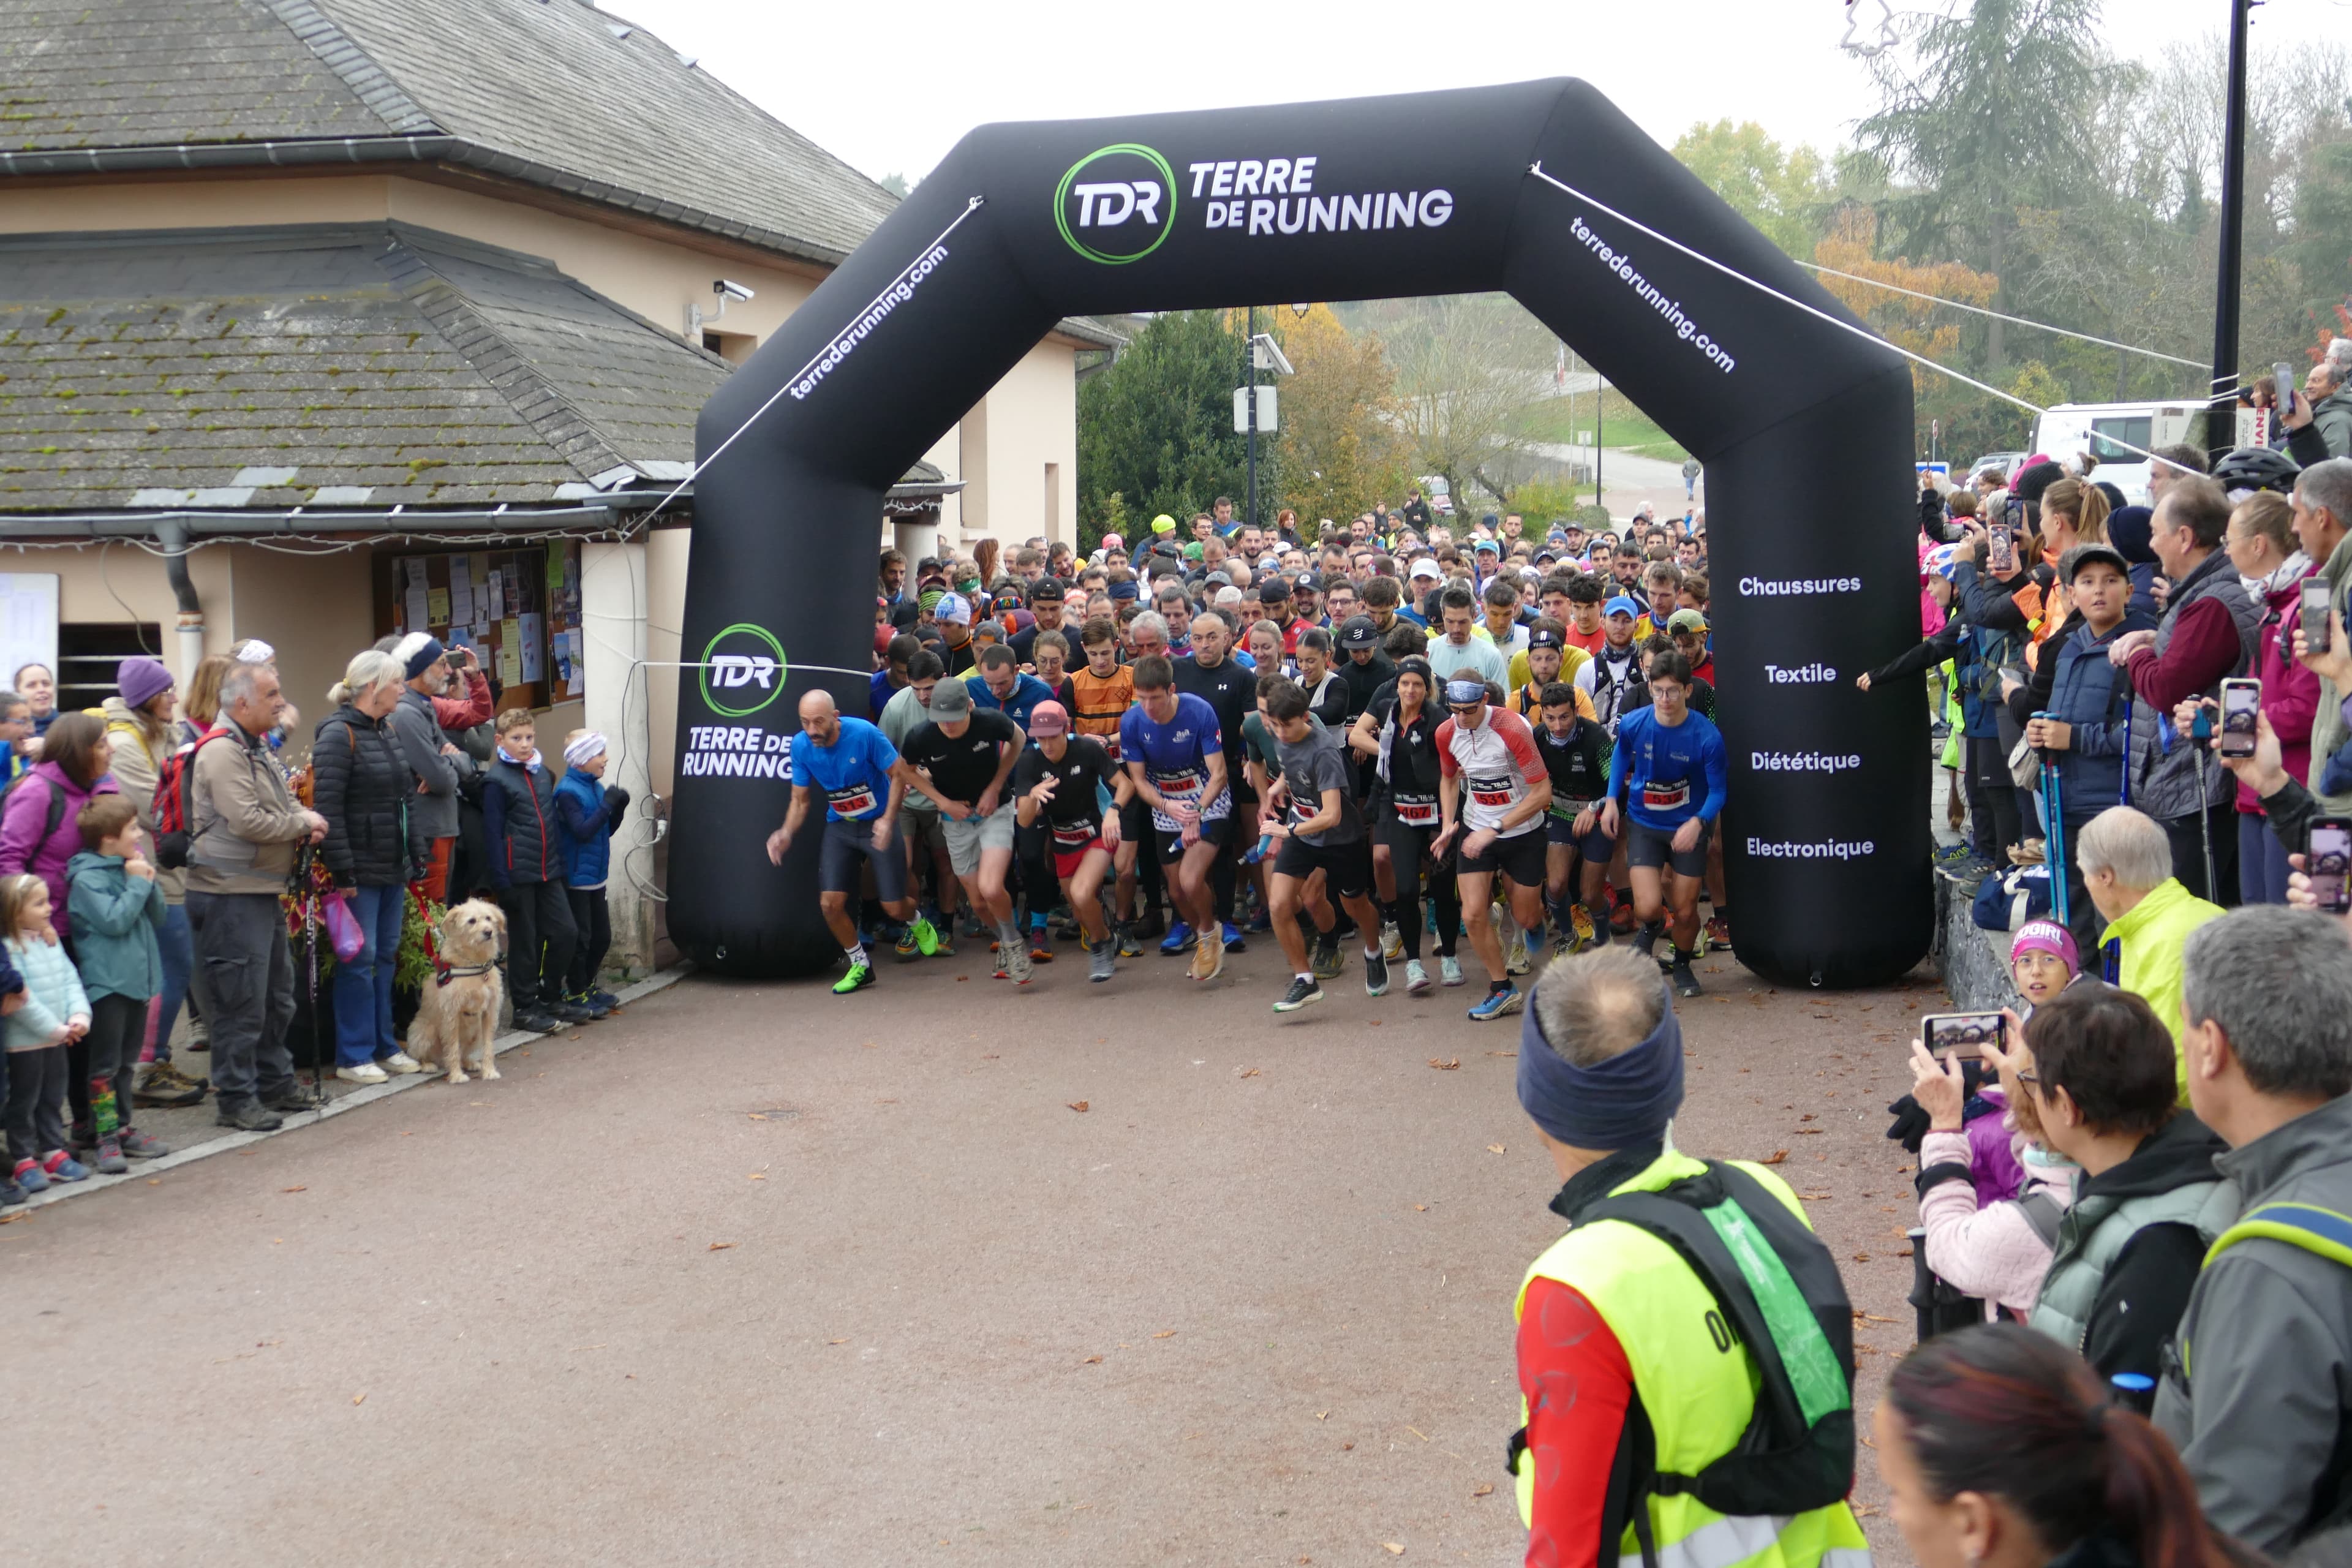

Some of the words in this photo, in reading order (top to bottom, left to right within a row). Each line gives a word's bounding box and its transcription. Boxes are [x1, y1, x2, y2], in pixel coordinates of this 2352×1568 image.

[1189, 157, 1317, 197] TERRE
[1074, 181, 1161, 227] TDR
[1205, 202, 1243, 228] DE
[1249, 189, 1453, 236] RUNNING
[1570, 216, 1735, 374] terrederunning.com
[790, 245, 949, 399] terrederunning.com
[2255, 407, 2264, 448] ENVI
[1739, 576, 1861, 597] Chaussures
[711, 655, 775, 689] TDR
[1765, 663, 1836, 684] Textile
[690, 727, 763, 751] TERRE
[682, 752, 794, 780] RUNNING
[1751, 752, 1861, 774] Diététique
[838, 797, 865, 812] 513
[1402, 805, 1430, 818] 467
[1479, 793, 1507, 804] 531
[1747, 837, 1874, 860] Electronique
